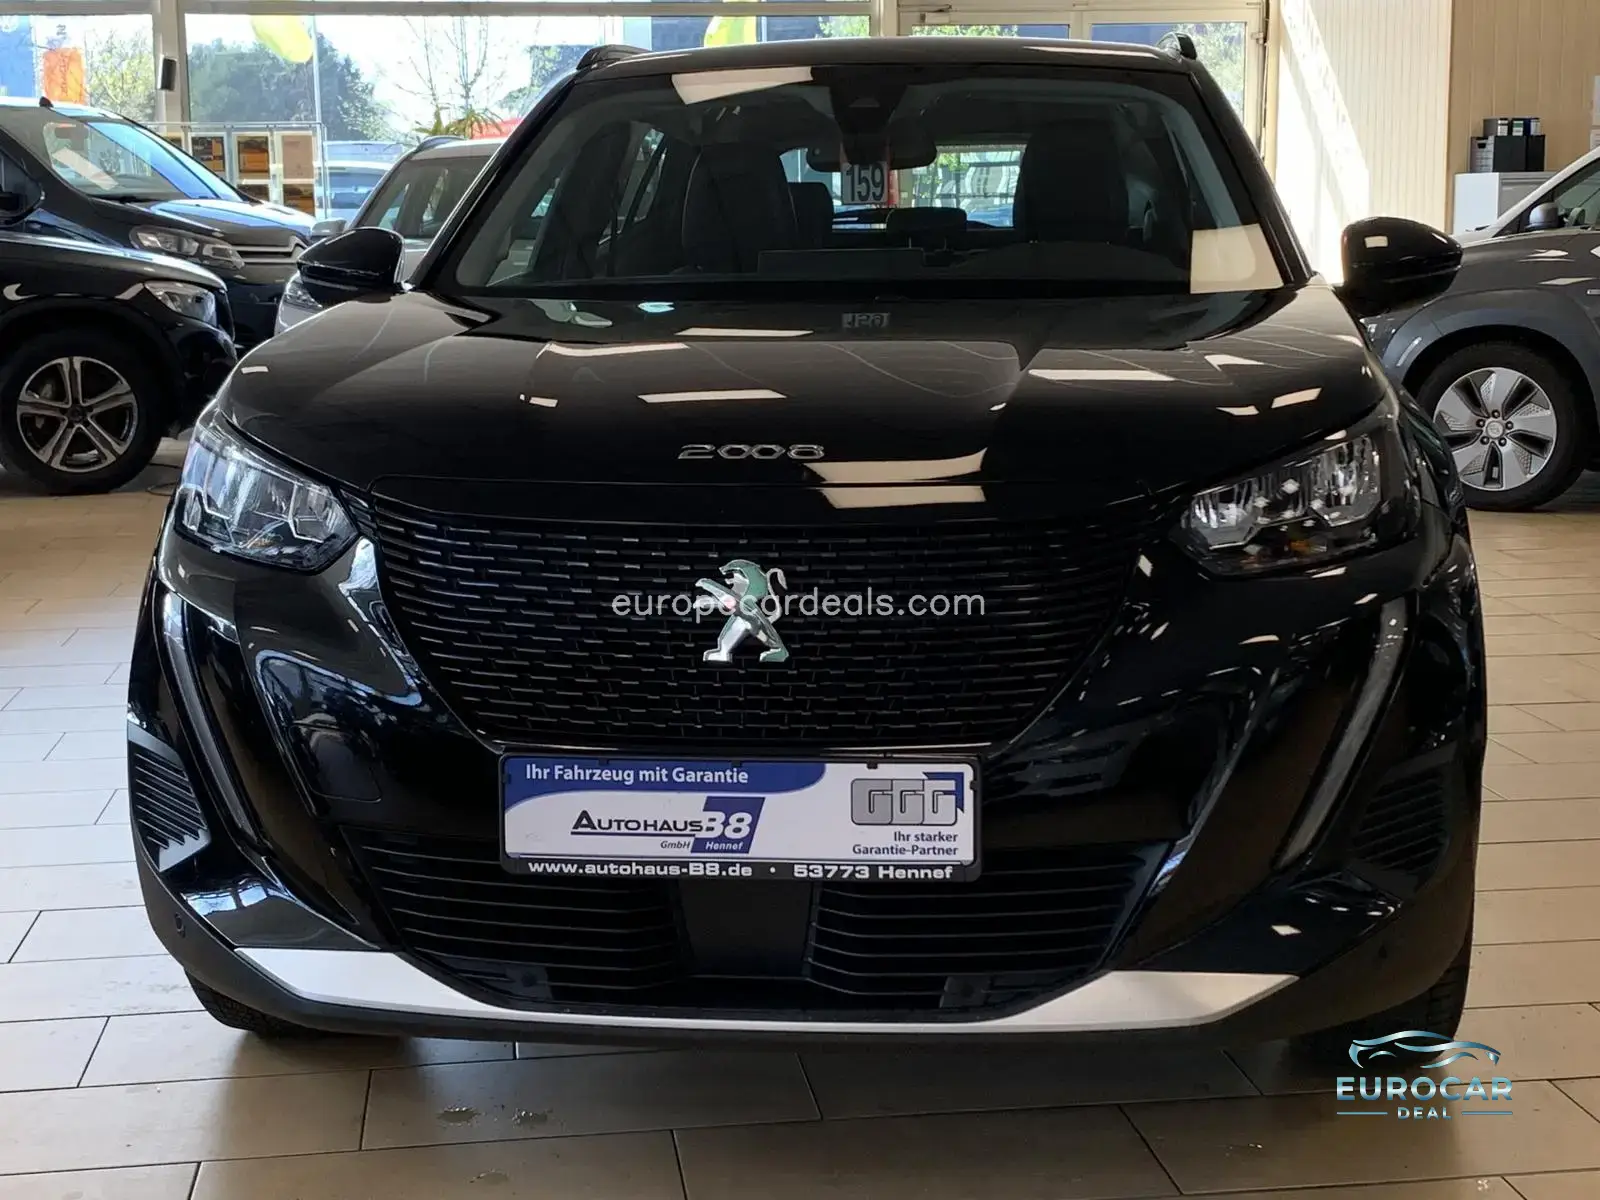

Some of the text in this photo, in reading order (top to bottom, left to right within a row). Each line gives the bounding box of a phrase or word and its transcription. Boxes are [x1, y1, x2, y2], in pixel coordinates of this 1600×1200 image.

[846, 162, 885, 202] 159
[678, 444, 825, 459] 2008
[526, 764, 749, 785] Ihr Fahrzeug mit Garantie
[894, 831, 958, 843] Ihr starker
[660, 840, 743, 851] GmbH Hennef
[852, 844, 958, 856] Garantie-Partner
[528, 862, 953, 879] www.autohaus-B8.de 53773 Hennef
